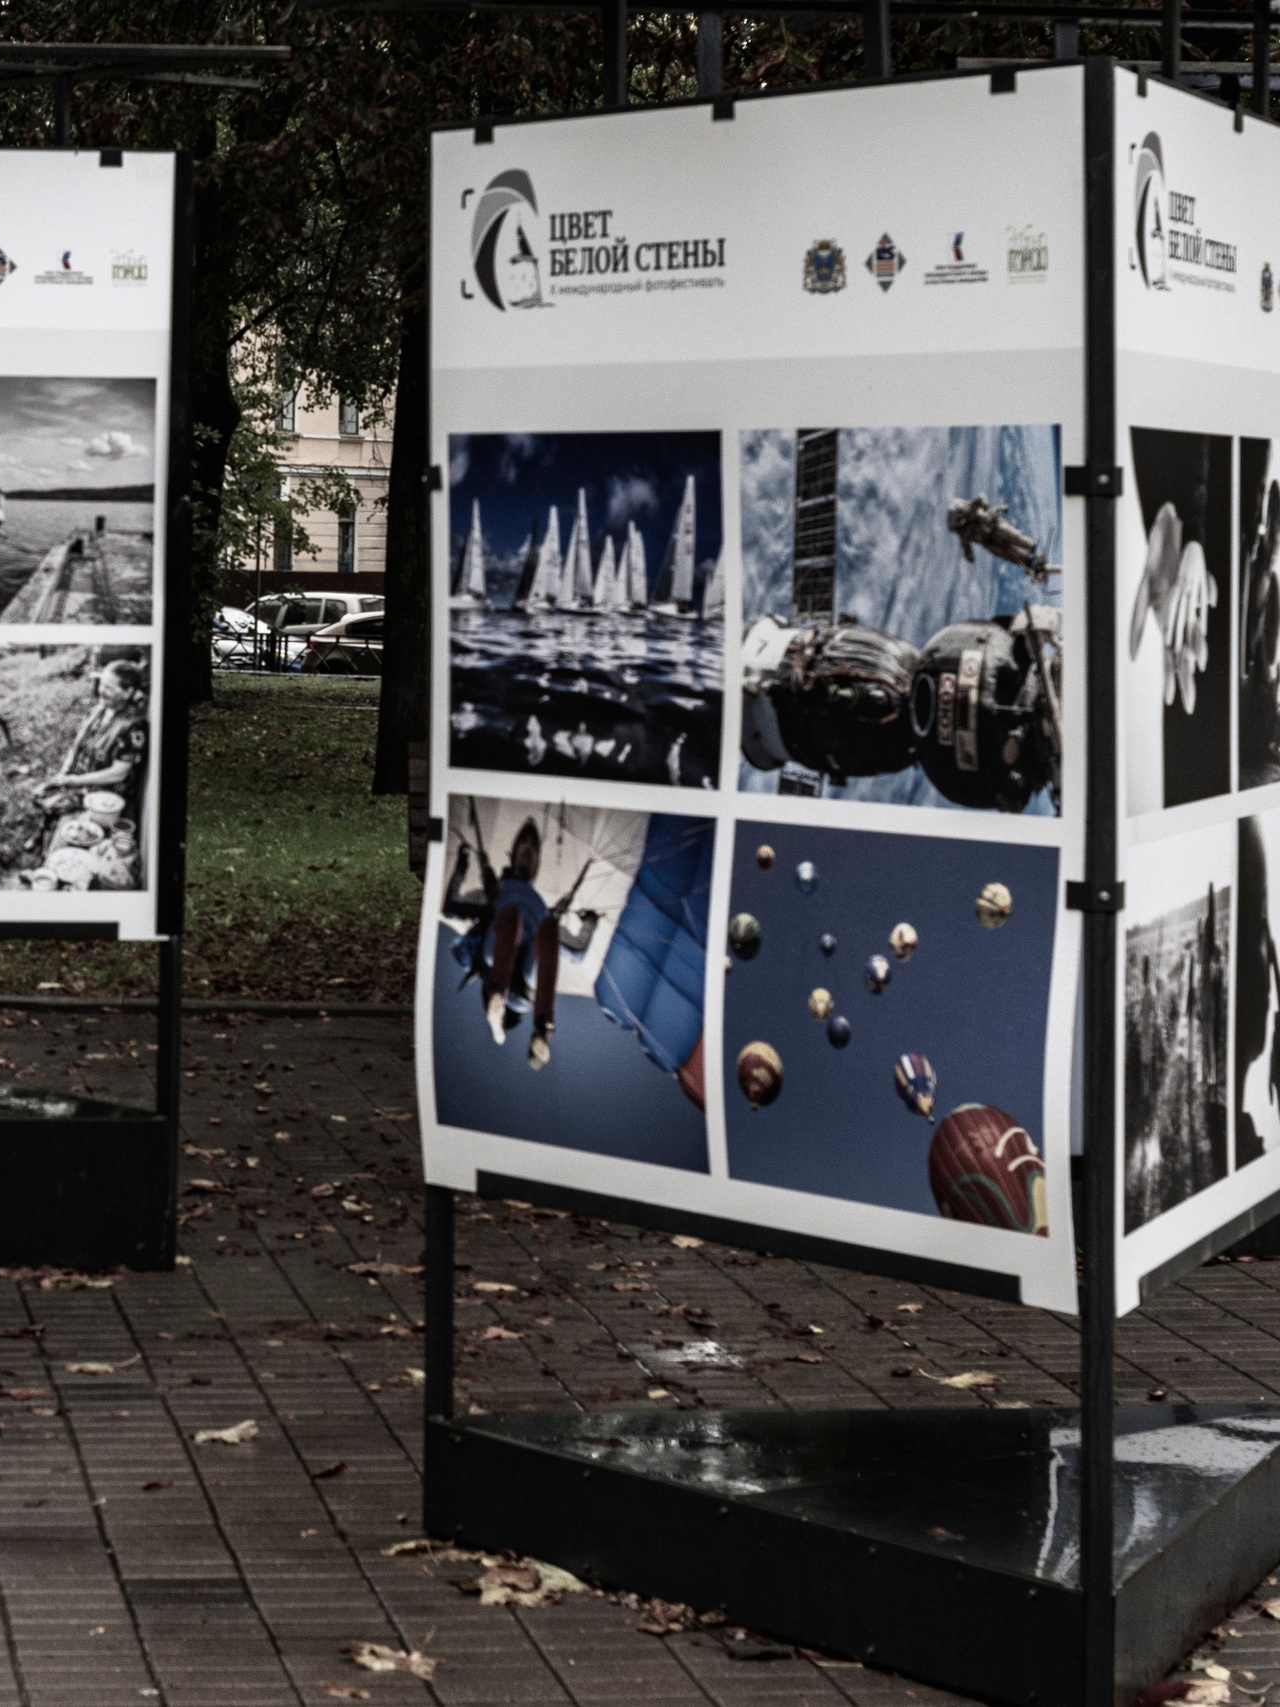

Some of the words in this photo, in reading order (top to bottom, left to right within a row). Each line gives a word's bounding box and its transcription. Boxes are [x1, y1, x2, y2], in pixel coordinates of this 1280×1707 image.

[549, 210, 613, 244] ЦВЕТ
[1169, 190, 1196, 226] ЦВЕТ
[549, 237, 630, 277] БЕЛОЙ
[635, 238, 726, 272] СТЕНЫ
[1169, 227, 1202, 265] БЕЛОЙ
[1204, 238, 1237, 273] СТЕНЫ
